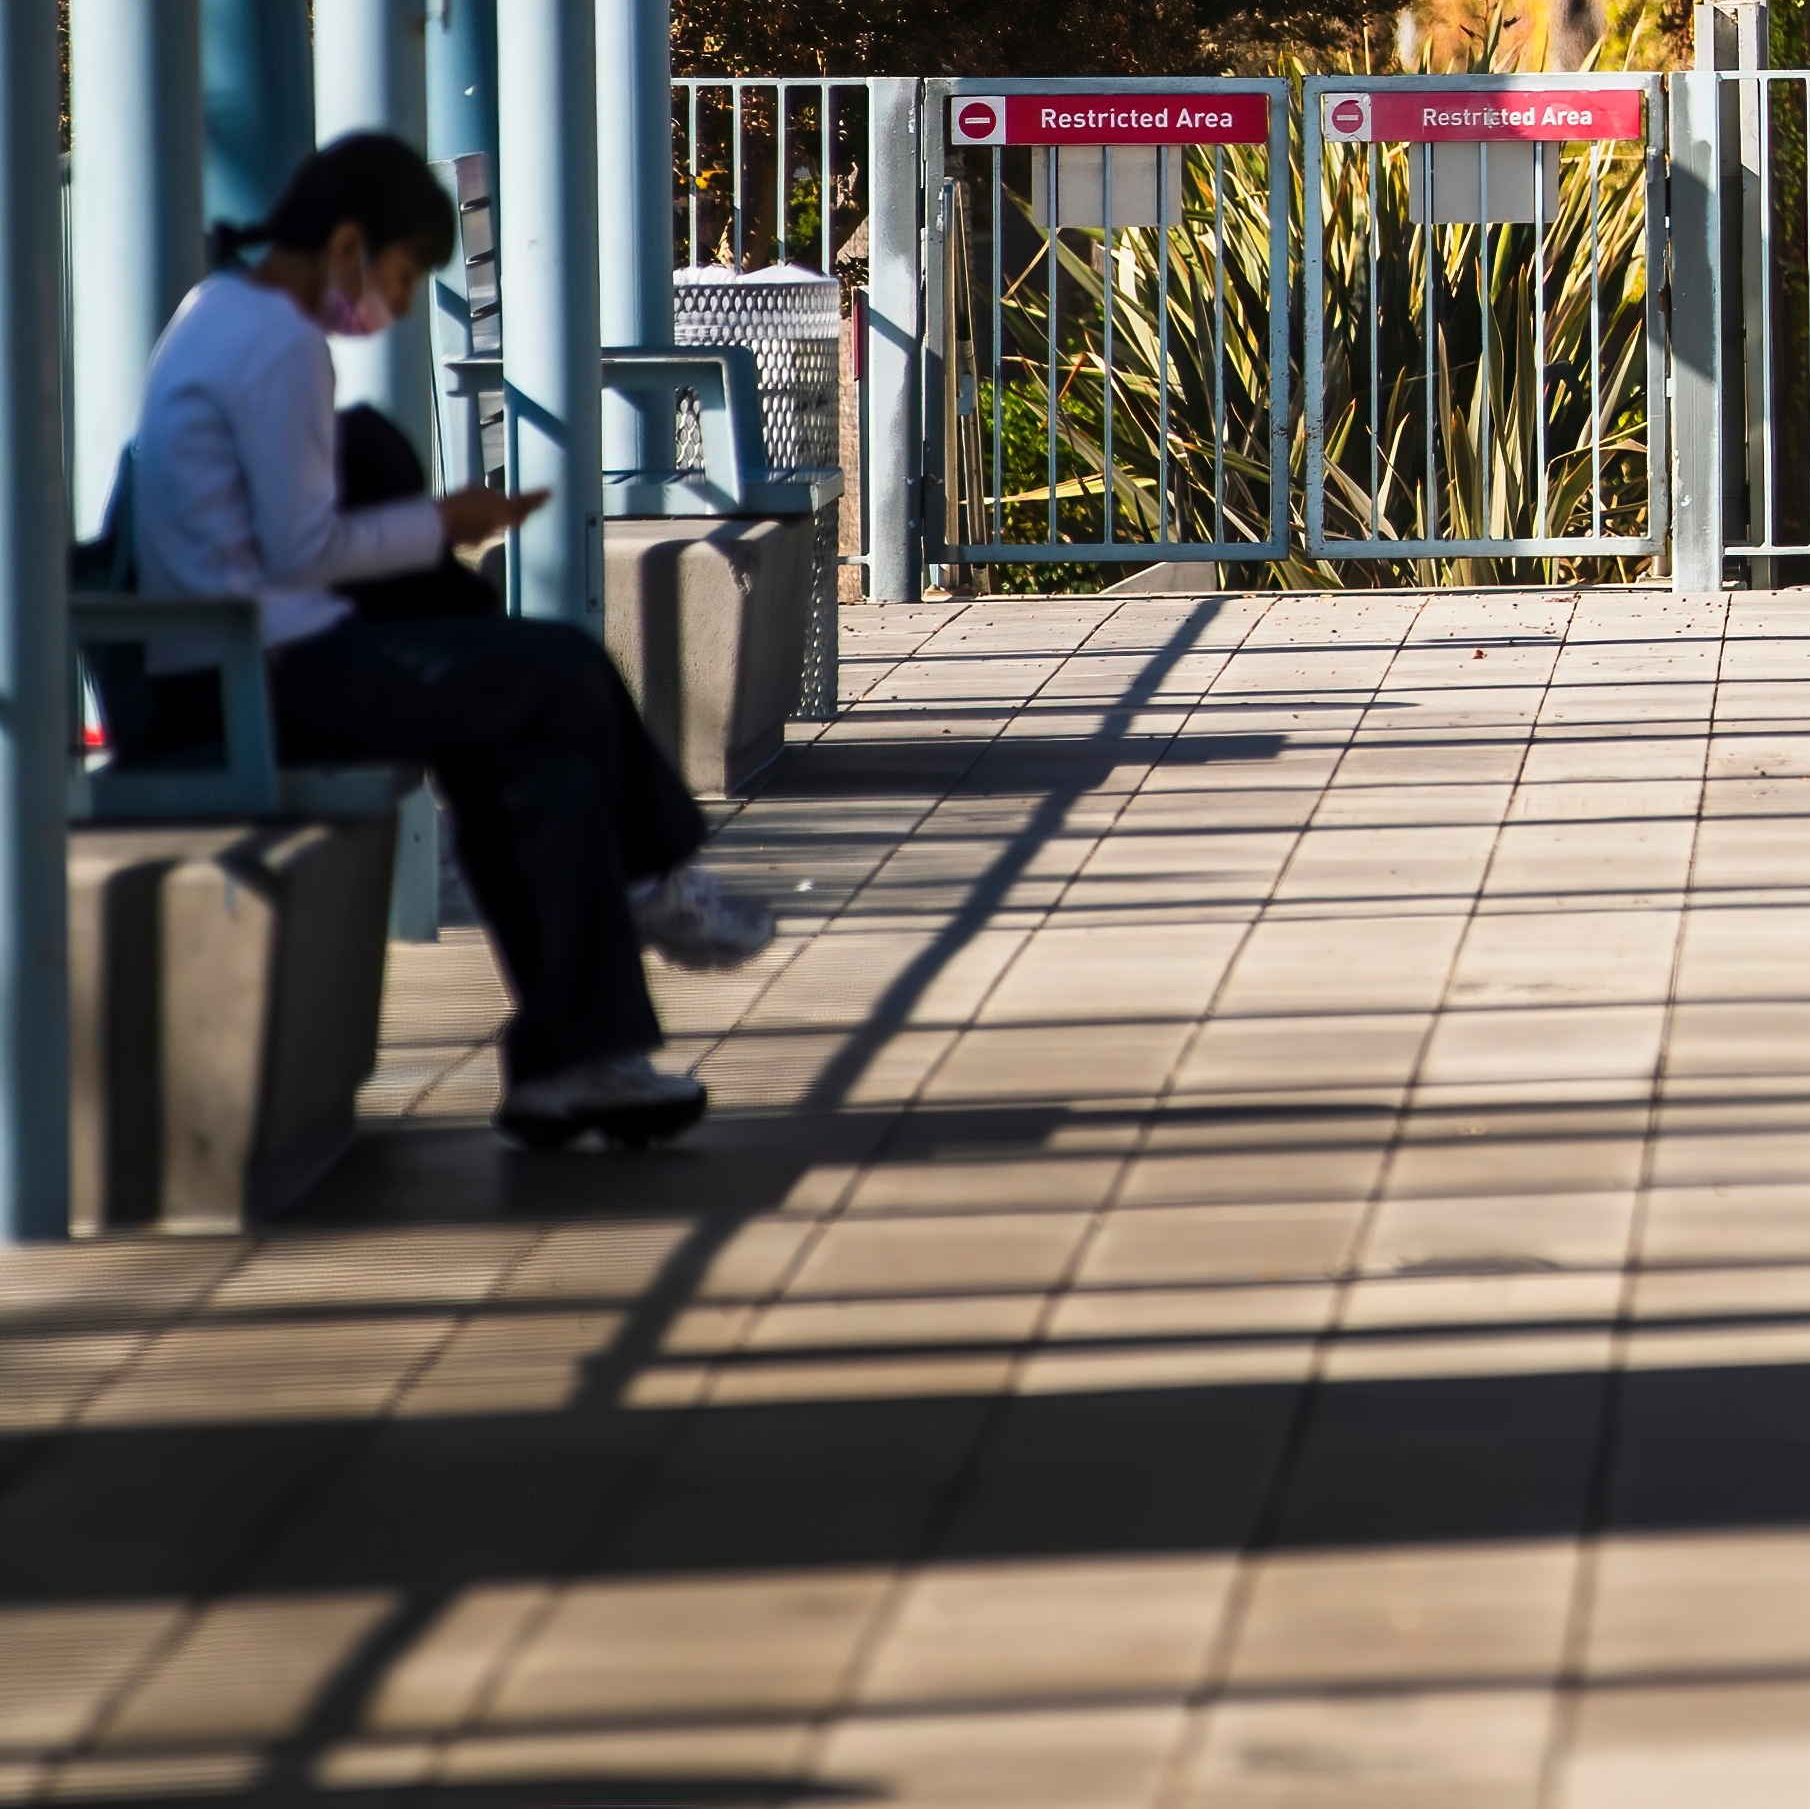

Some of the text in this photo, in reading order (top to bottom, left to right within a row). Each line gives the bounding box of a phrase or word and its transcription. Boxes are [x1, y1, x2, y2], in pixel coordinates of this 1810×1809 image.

[1040, 107, 1233, 129] Restricted Area
[1423, 107, 1593, 127] Restricted Area
